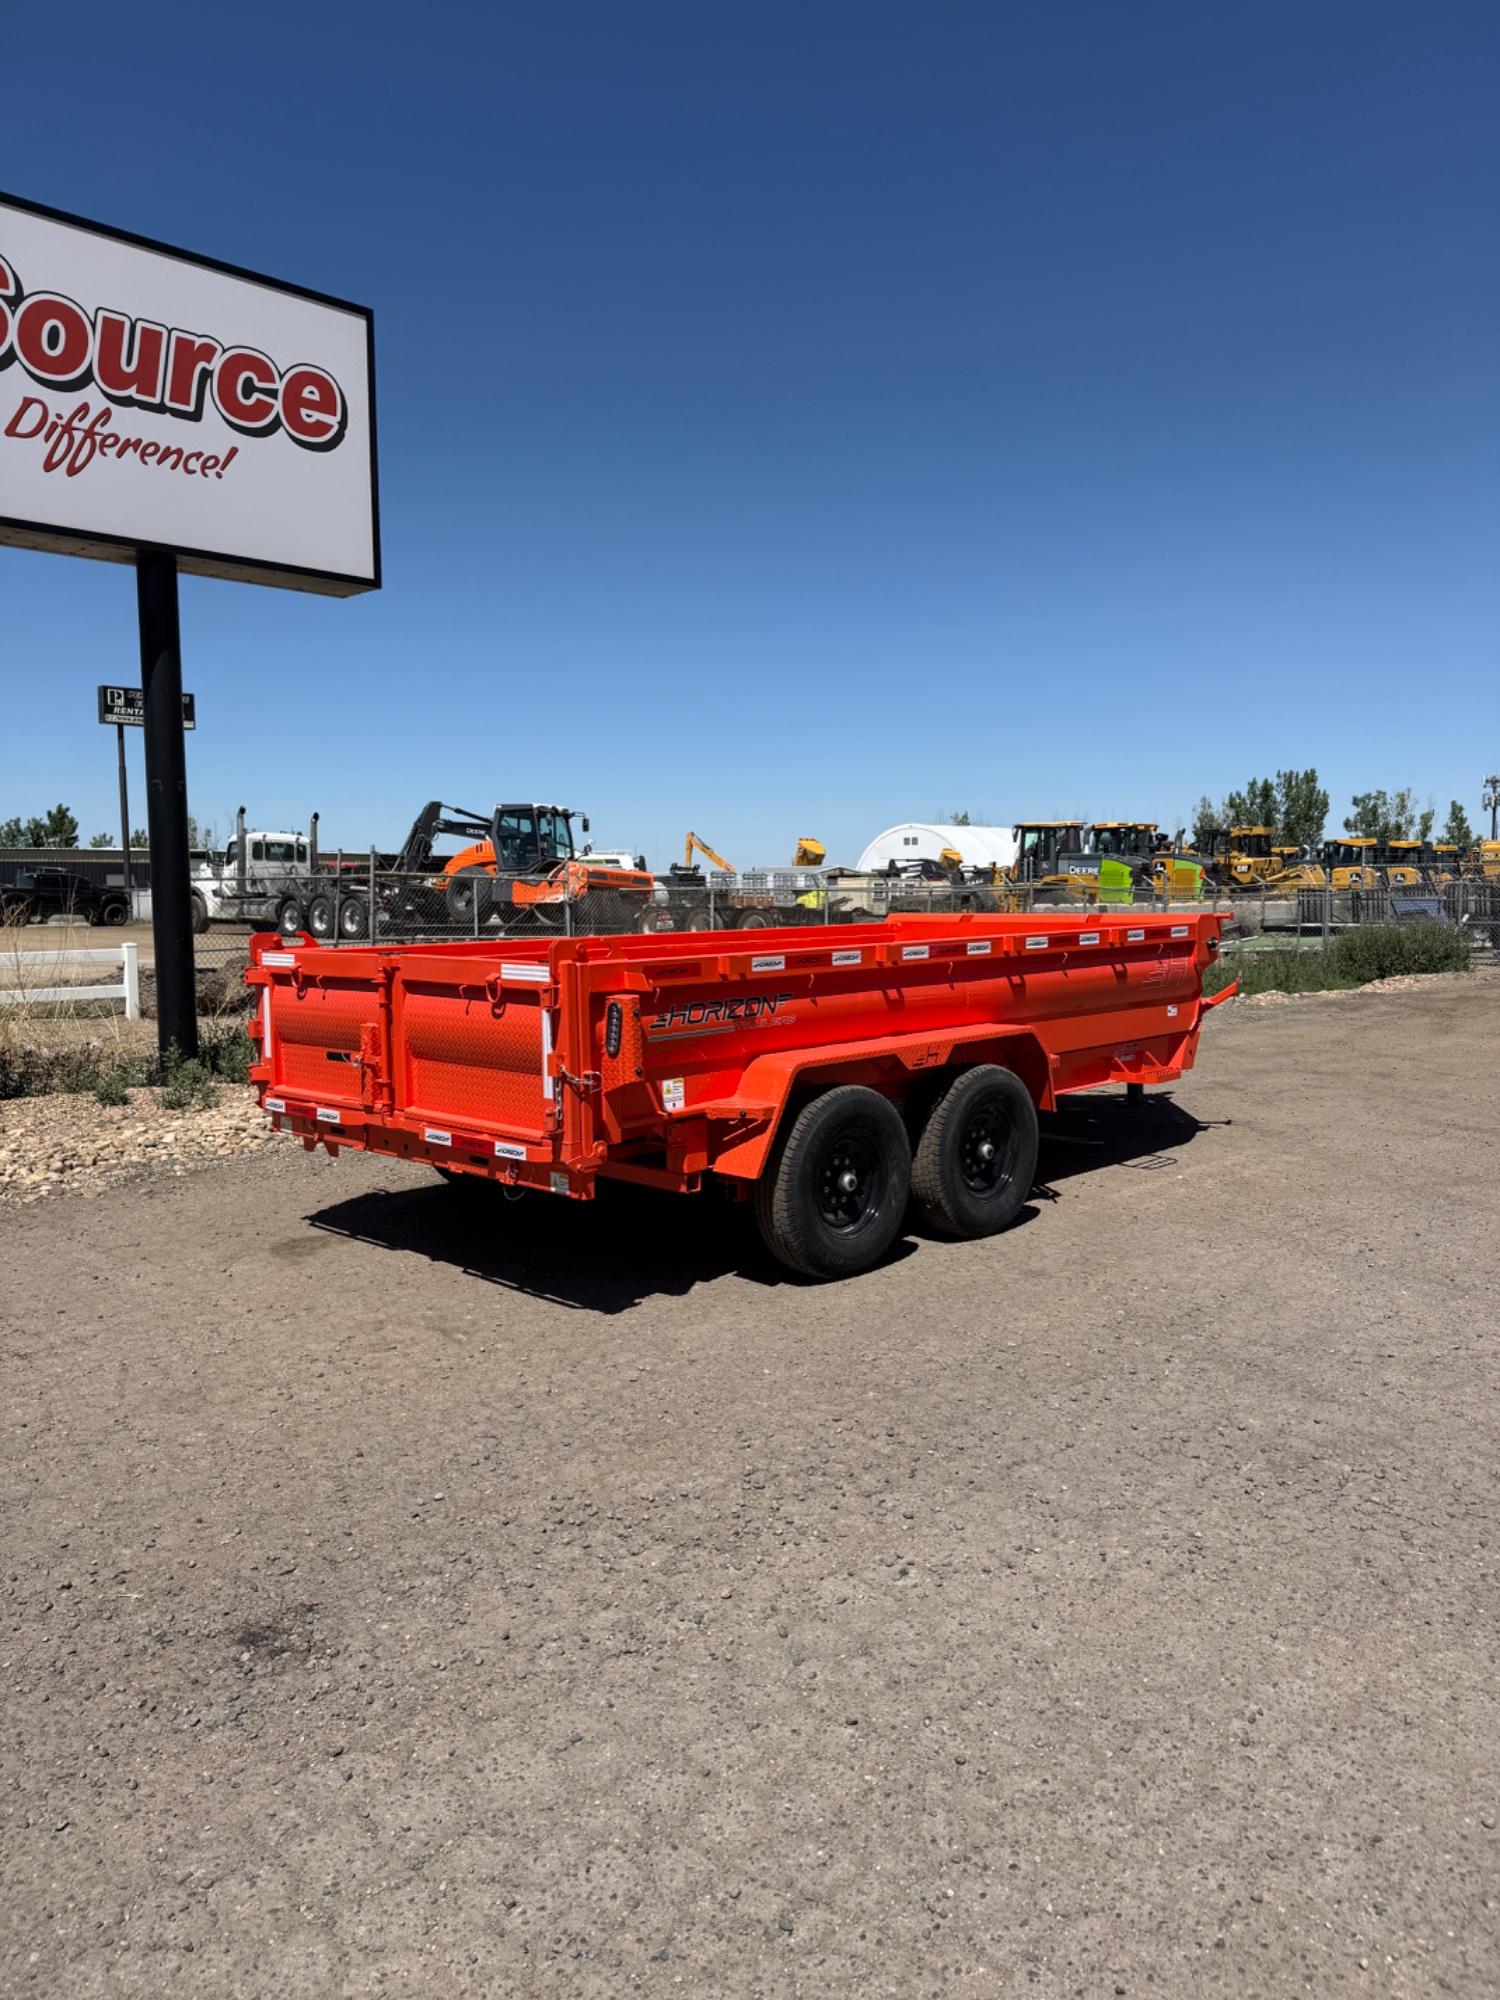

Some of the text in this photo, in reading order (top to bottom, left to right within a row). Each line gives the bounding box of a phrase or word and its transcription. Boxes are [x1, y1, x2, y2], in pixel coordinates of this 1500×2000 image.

[0, 252, 348, 453] ource
[4, 395, 239, 480] Difference!
[1069, 865, 1100, 876] DEERE
[666, 994, 780, 1027] HORIZON
